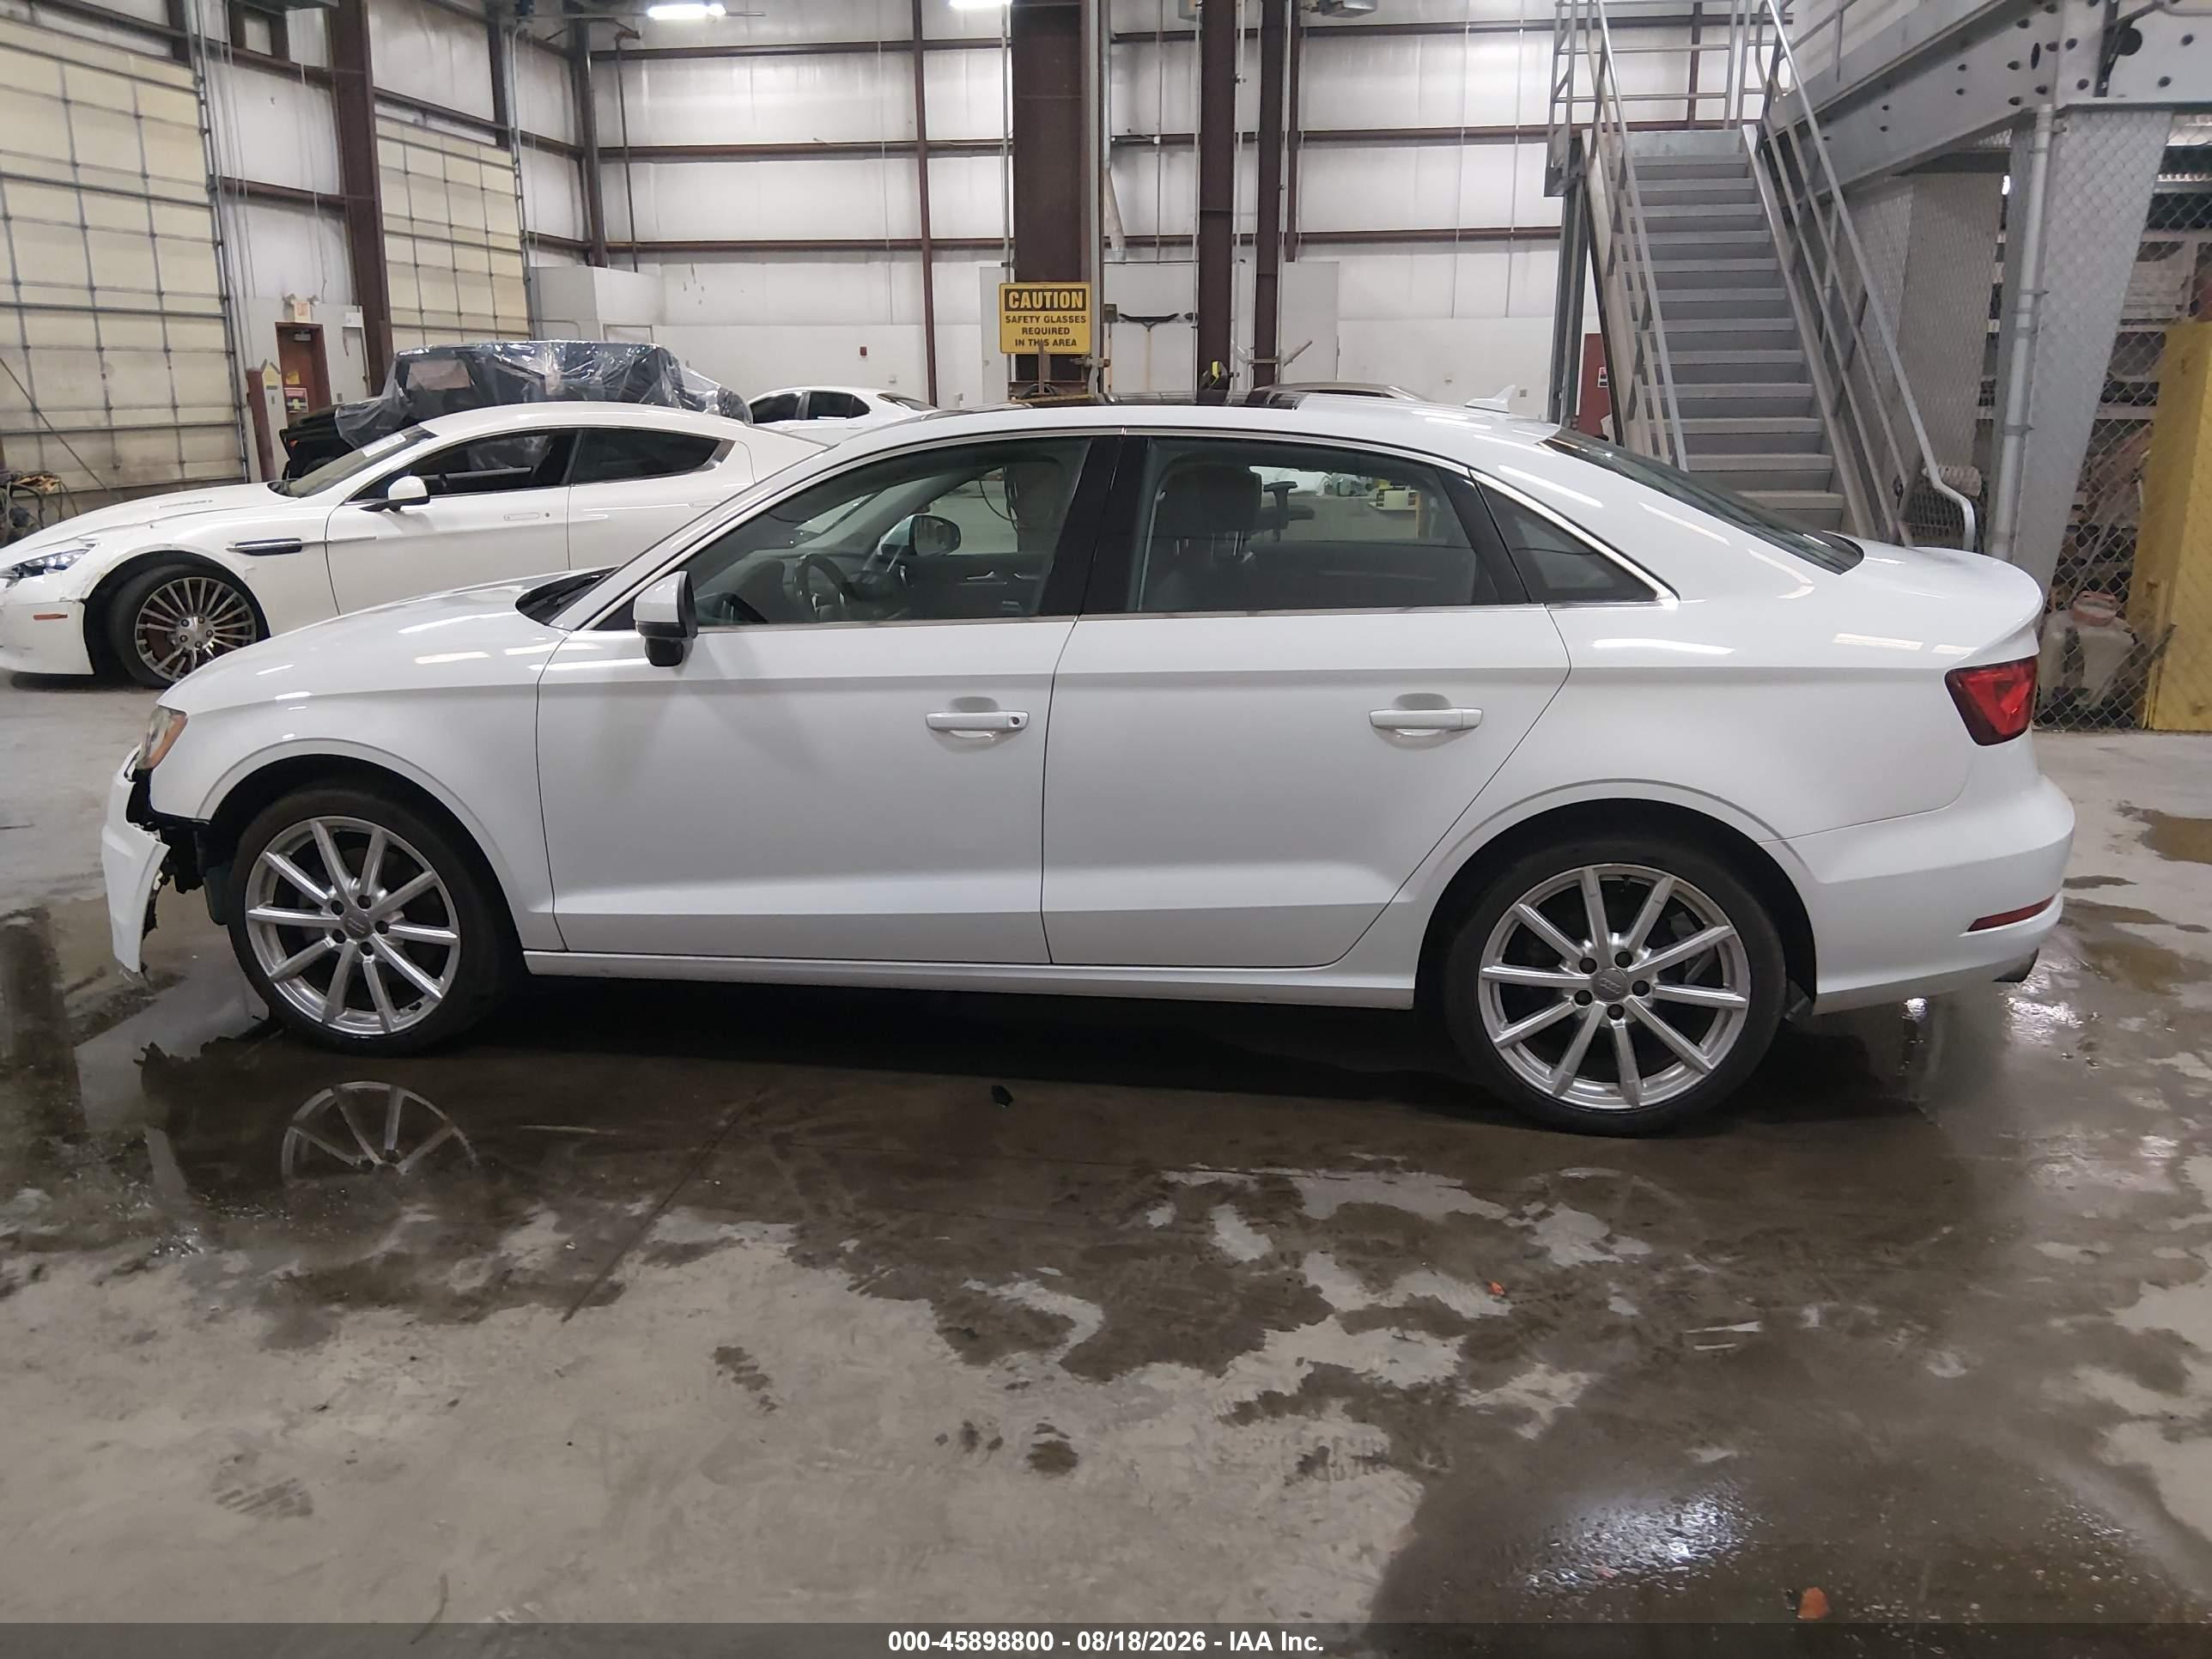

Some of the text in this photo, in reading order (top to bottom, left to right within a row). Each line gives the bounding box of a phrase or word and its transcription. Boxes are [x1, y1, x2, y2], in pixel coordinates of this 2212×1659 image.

[1009, 291, 1083, 309] CAUTION
[1006, 315, 1086, 324] SAFETY GLASSES
[1022, 326, 1070, 335] REQUIRED
[1015, 338, 1024, 347] IN
[1052, 338, 1077, 347] AREA
